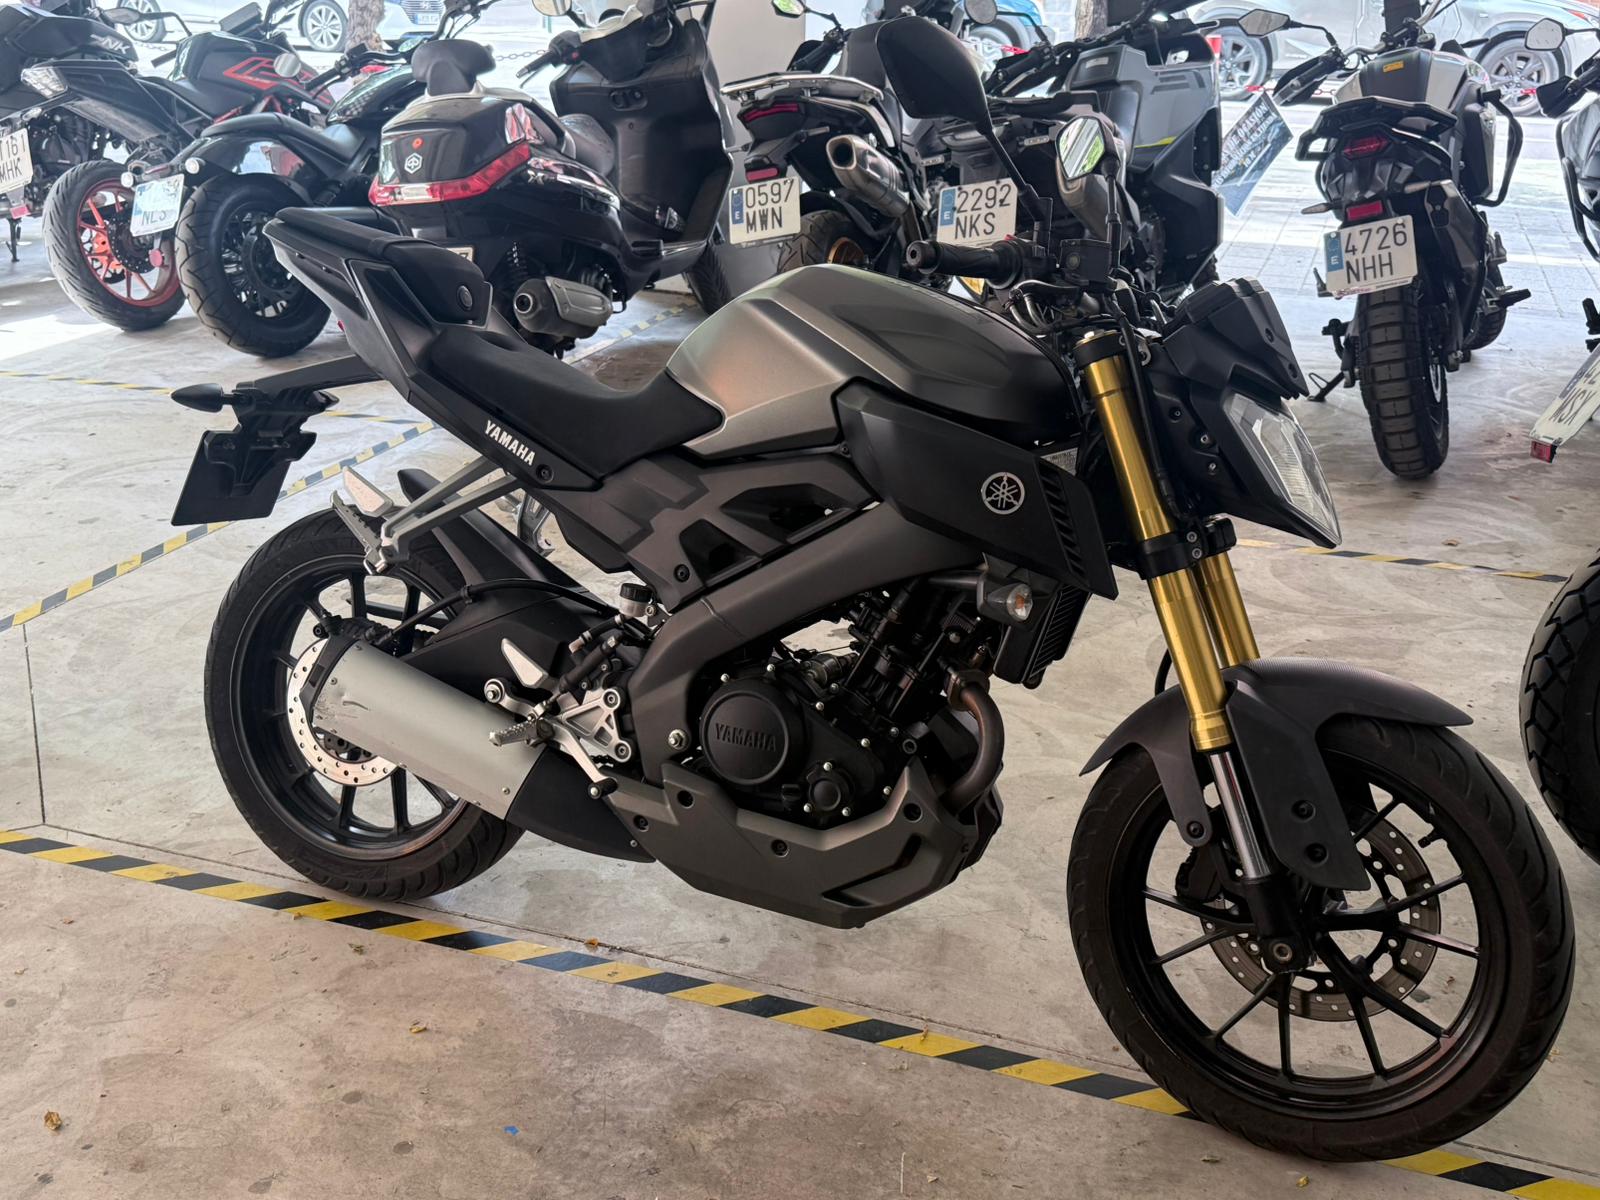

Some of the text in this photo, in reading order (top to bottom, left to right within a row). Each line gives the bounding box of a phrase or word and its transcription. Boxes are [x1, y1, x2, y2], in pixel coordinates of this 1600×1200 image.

[745, 178, 795, 209] 0597
[956, 183, 1012, 214] 2292
[734, 210, 741, 220] E
[745, 206, 783, 234] MWN
[943, 210, 951, 220] E
[954, 211, 996, 240] NKS
[1344, 222, 1408, 256] 4726
[1330, 255, 1339, 265] E
[1345, 251, 1394, 285] NHH
[1548, 387, 1598, 427] MSX
[484, 419, 536, 466] YAMAHA
[715, 722, 776, 752] YAMAHA
